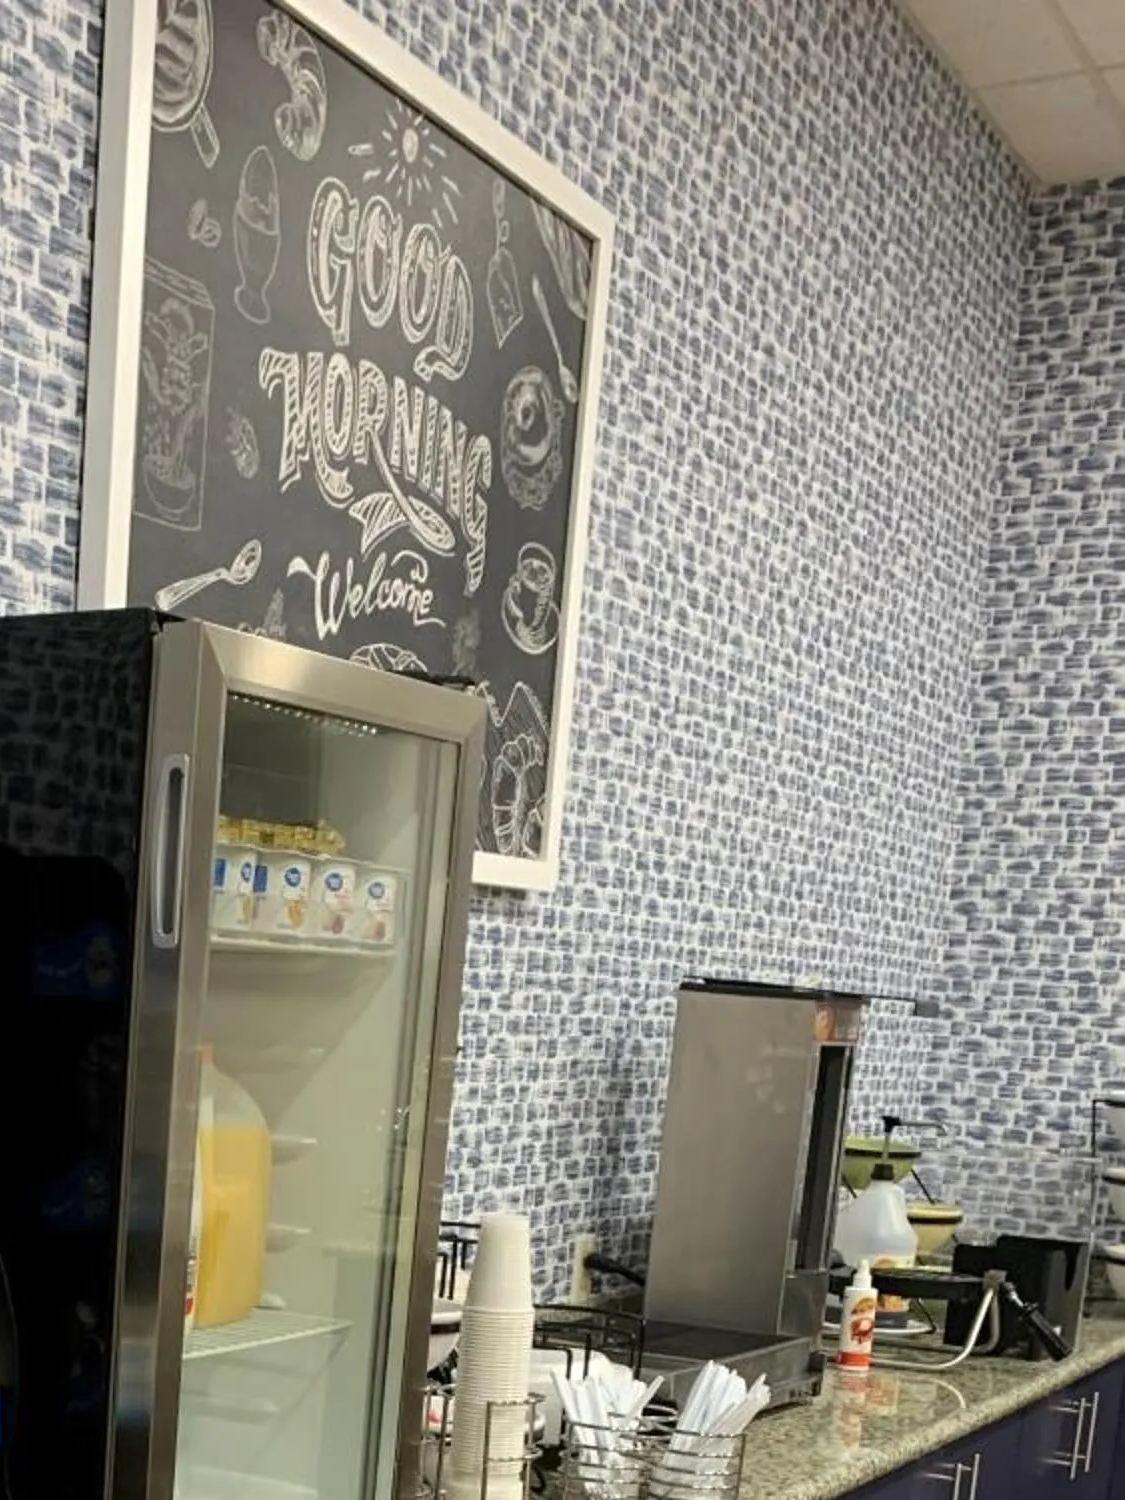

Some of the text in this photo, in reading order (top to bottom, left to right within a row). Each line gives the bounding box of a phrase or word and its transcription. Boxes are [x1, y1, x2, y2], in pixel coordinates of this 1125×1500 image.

[307, 176, 474, 382] GOOD
[258, 346, 493, 598] MORNING
[286, 550, 446, 640] Welcome
